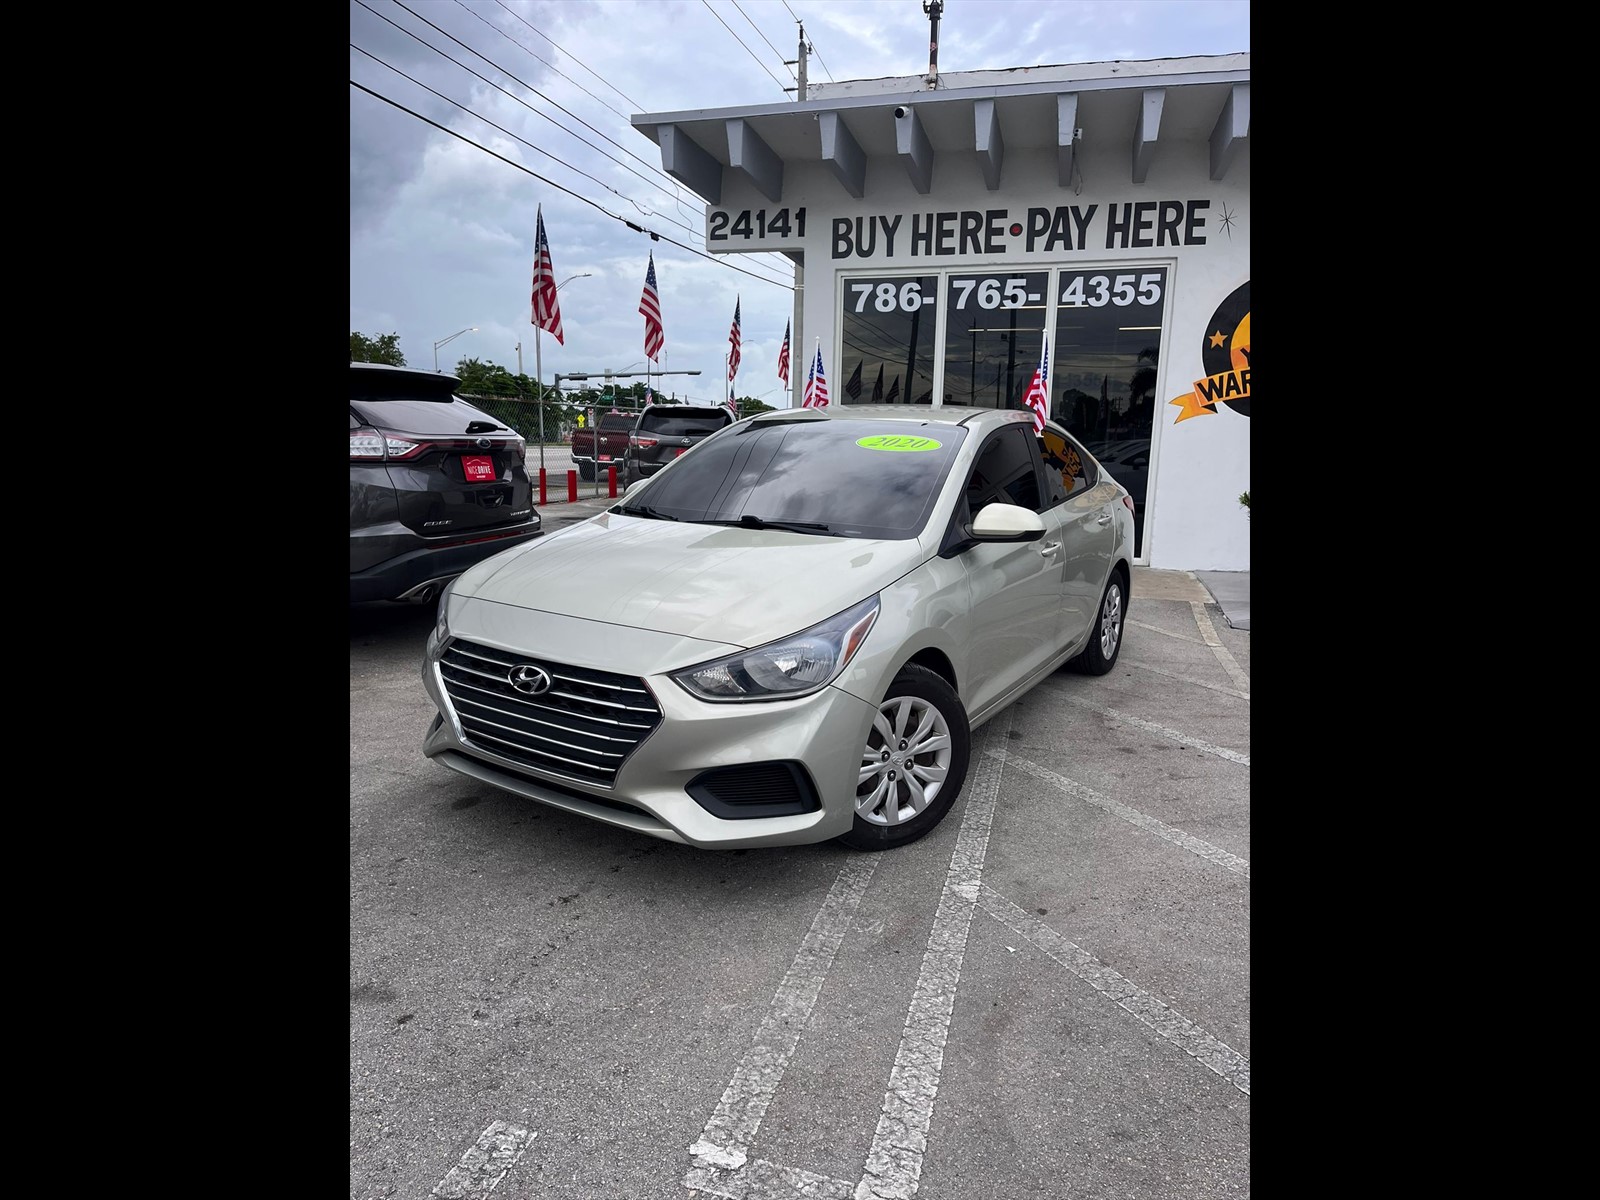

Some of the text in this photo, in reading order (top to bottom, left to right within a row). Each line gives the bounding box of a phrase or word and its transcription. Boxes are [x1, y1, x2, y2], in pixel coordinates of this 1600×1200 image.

[709, 207, 807, 240] 24141
[832, 199, 1211, 260] BUY HERE PAY HERE
[851, 273, 1162, 313] 786- 765- 4355
[866, 437, 930, 449] 2020
